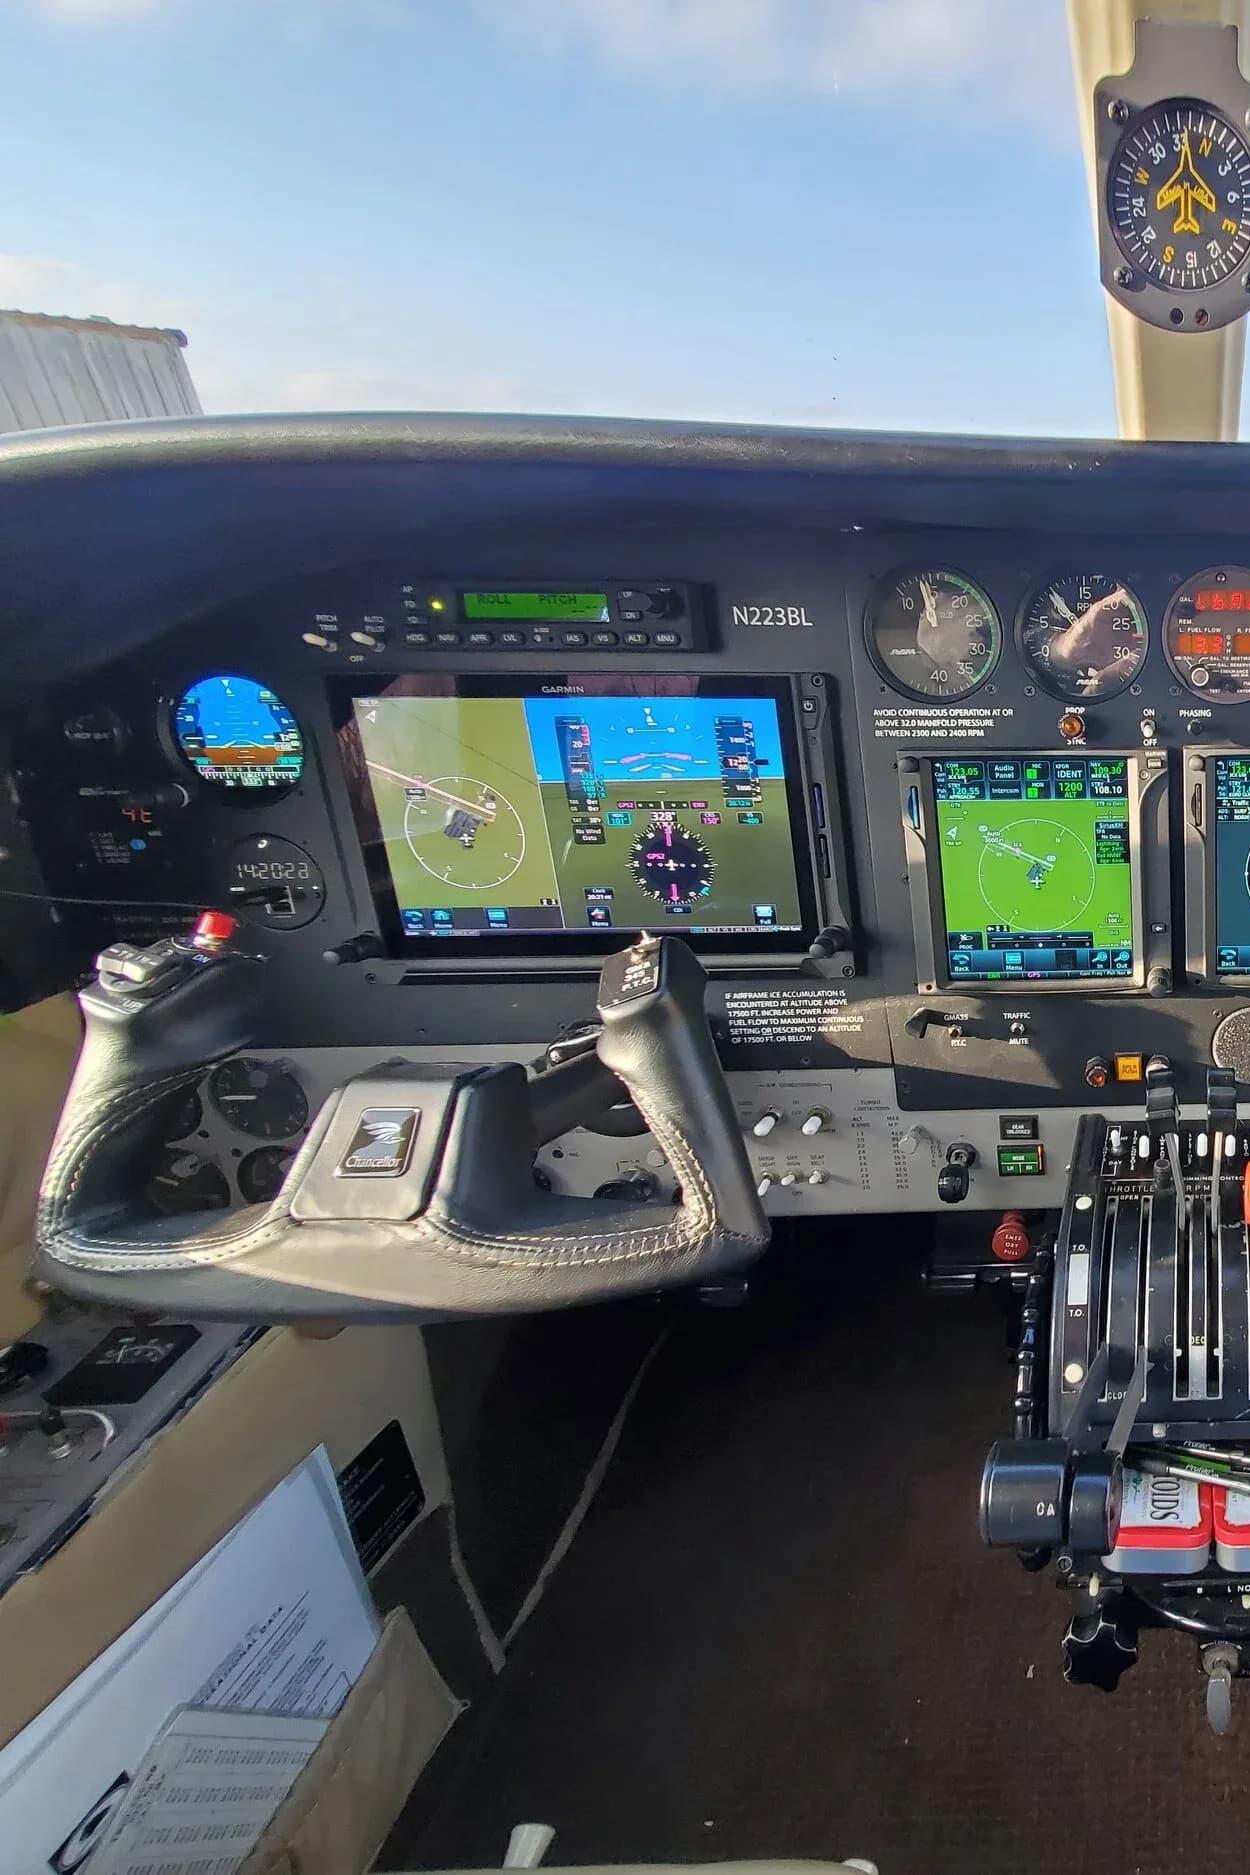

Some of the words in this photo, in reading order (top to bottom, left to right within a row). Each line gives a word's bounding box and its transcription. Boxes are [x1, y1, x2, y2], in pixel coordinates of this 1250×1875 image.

[1148, 143, 1166, 164] 30
[1199, 141, 1212, 157] N
[1136, 167, 1151, 185] W
[1219, 163, 1232, 177] 3
[1227, 192, 1240, 204] 6
[1133, 198, 1146, 218] 24
[1221, 219, 1237, 234] E
[1140, 226, 1156, 245] 21
[1163, 246, 1175, 263] S
[1207, 240, 1222, 259] 12
[1079, 587, 1092, 600] 15
[902, 597, 914, 611] 10
[951, 595, 968, 609] 20
[731, 605, 814, 628] N223BL
[966, 615, 983, 628] 25
[1039, 616, 1049, 629] 5
[1112, 617, 1131, 631] 25
[969, 643, 986, 655] 30
[1041, 646, 1050, 658] 0
[1113, 646, 1131, 659] 30
[957, 662, 974, 675] 35
[930, 670, 948, 682] 40
[541, 685, 584, 694] GARMIN
[873, 709, 896, 717] AVOID
[898, 709, 947, 717] CONTINUOUS
[949, 708, 991, 716] OPERATION
[992, 708, 1001, 716] AT
[1002, 708, 1013, 717] OR
[1143, 709, 1155, 717] ON
[1179, 709, 1212, 718] PHASING
[875, 719, 899, 727] ABOVE
[901, 719, 916, 727] 32.0
[917, 719, 957, 727] MANIFOLD
[958, 719, 994, 727] PRESSURE
[875, 729, 910, 737] BETWEEN
[912, 729, 929, 737] 2300
[931, 729, 947, 737] AND
[948, 729, 967, 737] 2400
[968, 729, 985, 737] RPM
[1143, 738, 1158, 747] OFF
[951, 787, 979, 795] 120.55
[1059, 782, 1082, 791] 1200
[1095, 786, 1122, 794] 108.10
[192, 954, 210, 963] DN
[123, 999, 145, 1008] UP
[780, 1017, 816, 1025] MAXIMUM
[818, 1016, 864, 1024] CONTINUOUS
[1003, 1012, 1031, 1020] TRAFFIC
[730, 1028, 760, 1036] SETTING
[1009, 1037, 1029, 1046] MUTE
[344, 1154, 402, 1170] Chancellor
[1227, 1585, 1232, 1593] L
